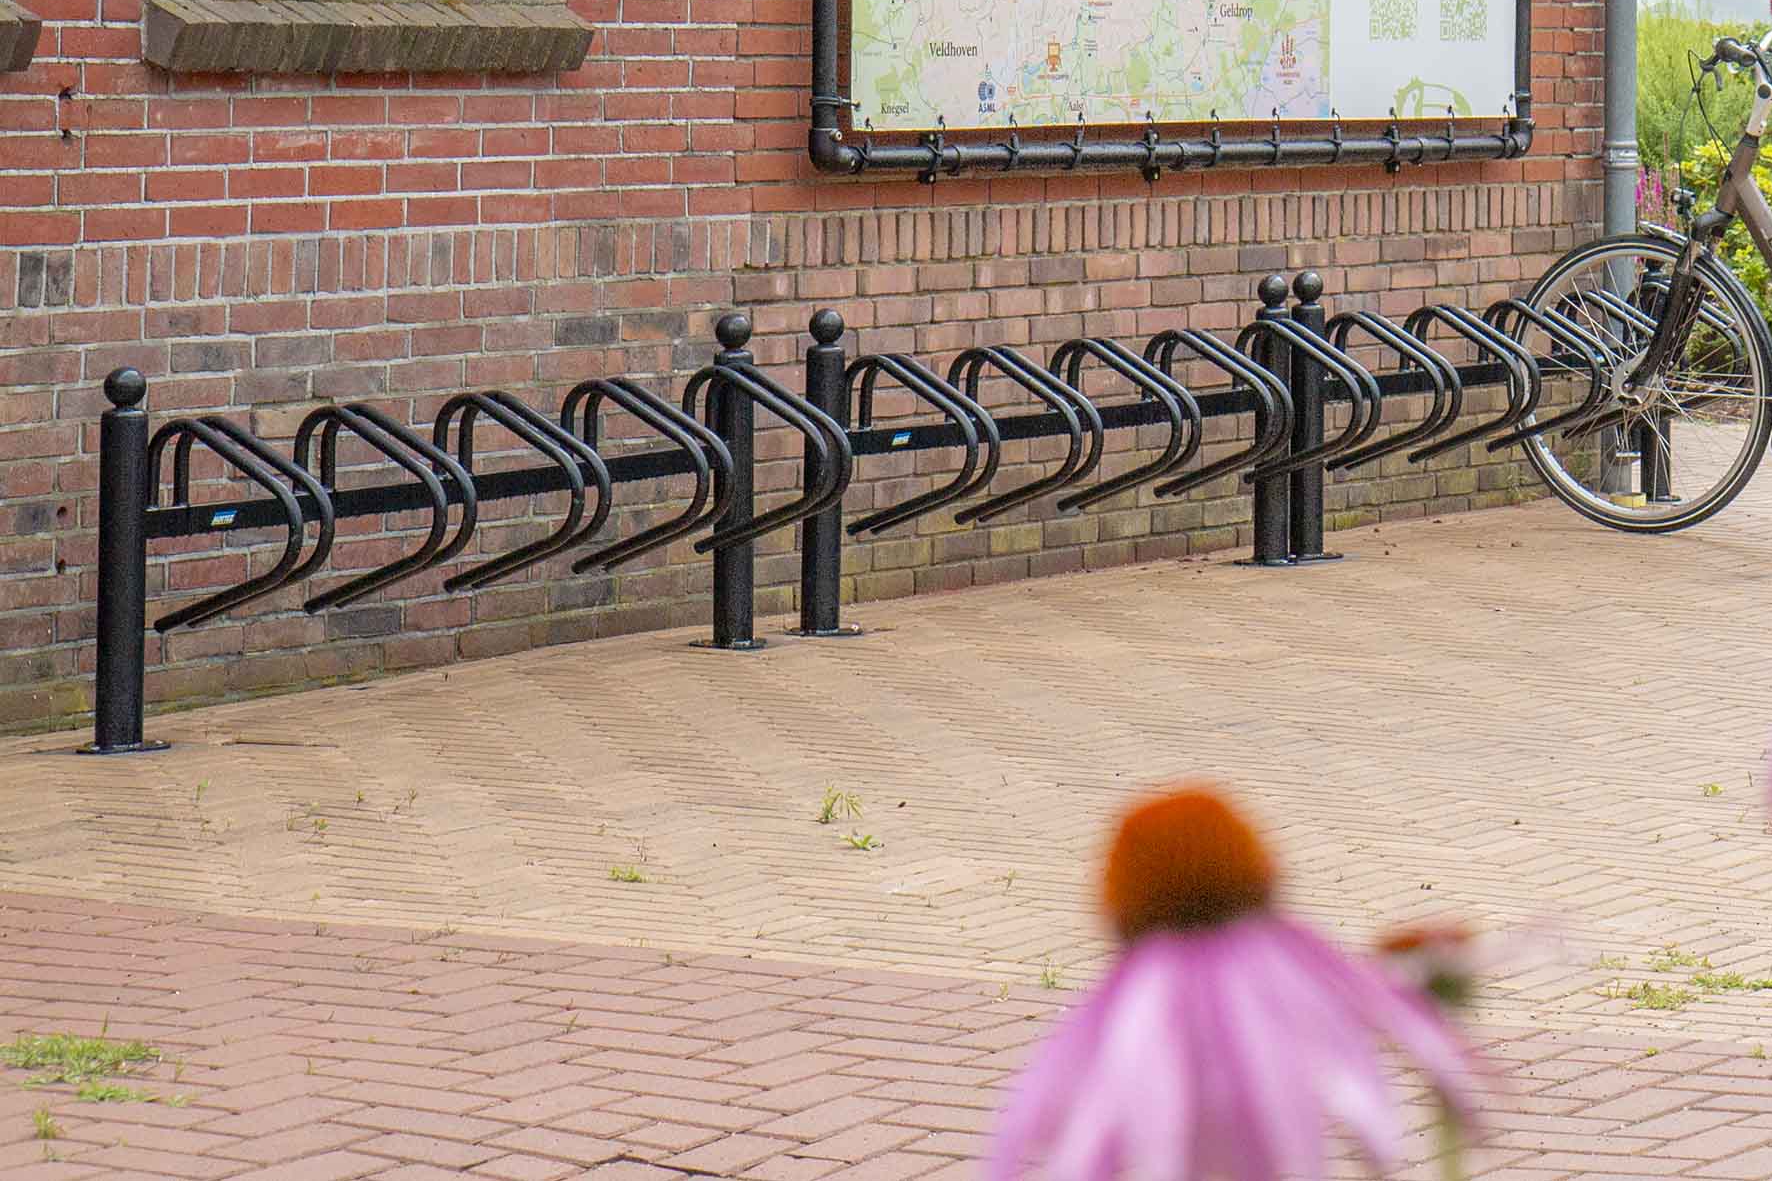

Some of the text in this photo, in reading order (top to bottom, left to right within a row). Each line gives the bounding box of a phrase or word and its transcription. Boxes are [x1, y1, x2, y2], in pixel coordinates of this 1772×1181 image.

[1219, 3, 1253, 21] Geldrop
[929, 42, 978, 57] Veldhoven
[880, 102, 910, 116] Knegsel
[978, 103, 996, 113] ASML
